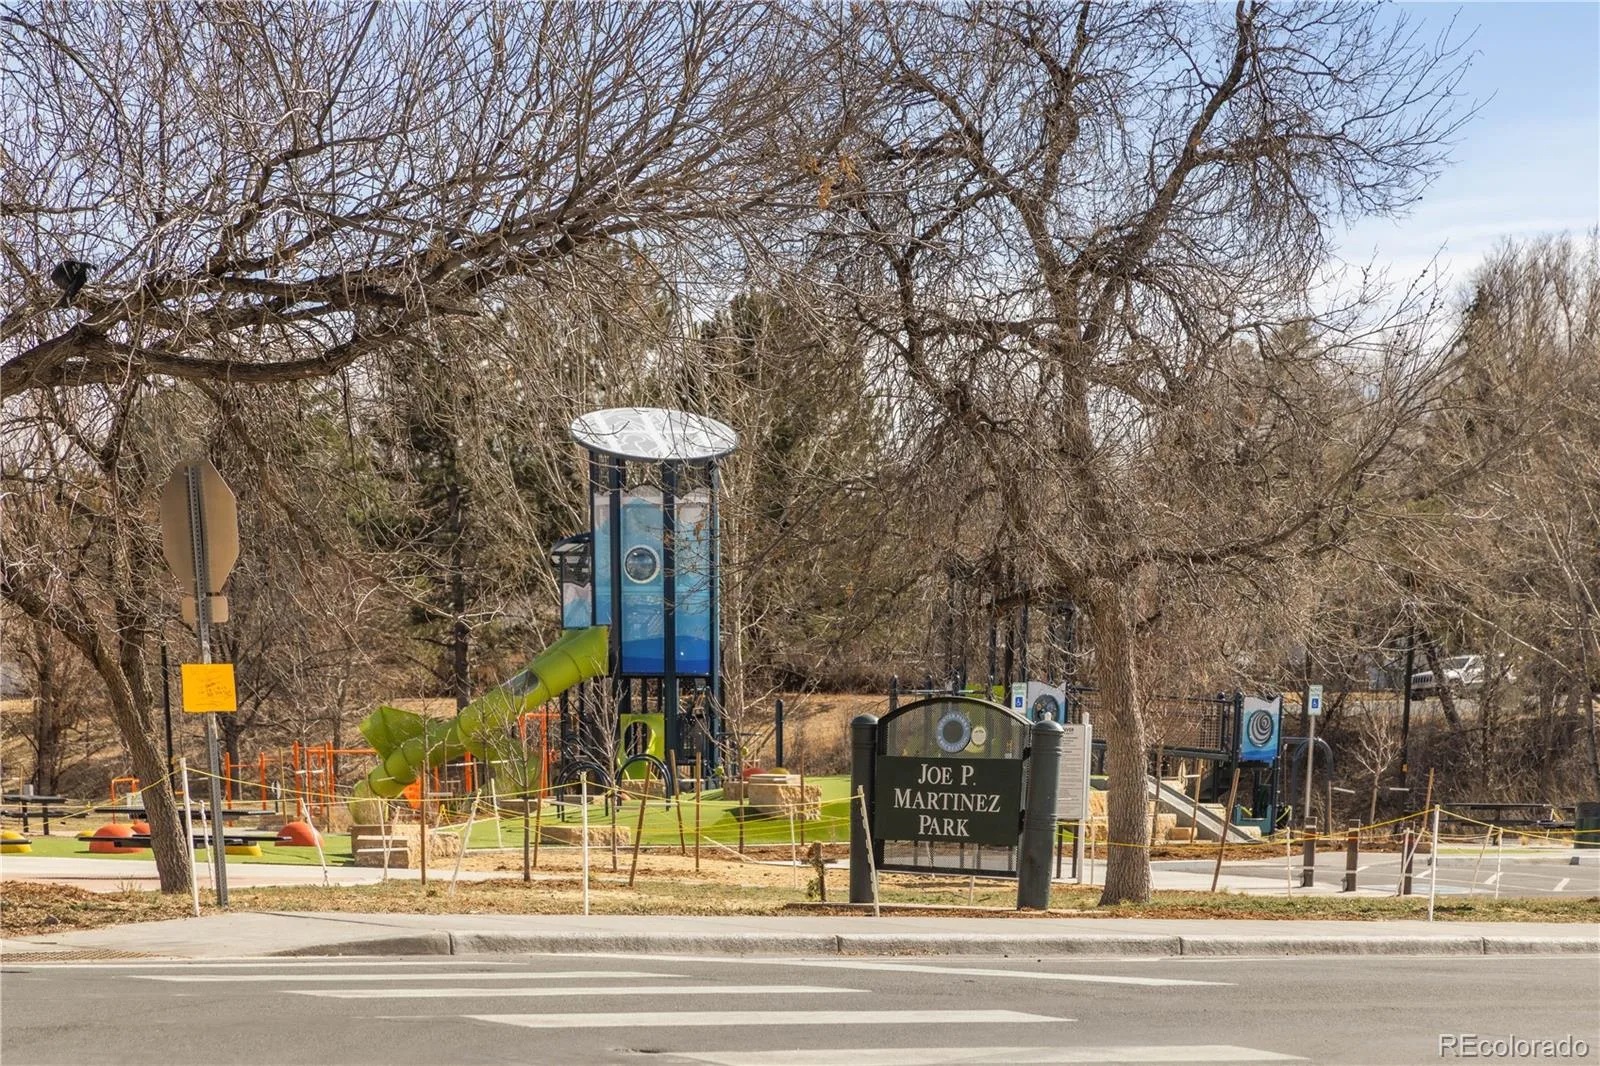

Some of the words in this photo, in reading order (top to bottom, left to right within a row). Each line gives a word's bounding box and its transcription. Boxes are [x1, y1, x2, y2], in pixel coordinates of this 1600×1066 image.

[918, 763, 953, 785] JOE
[960, 765, 976, 786] P.
[893, 788, 1001, 813] MARTINEZ
[918, 814, 970, 837] PARK
